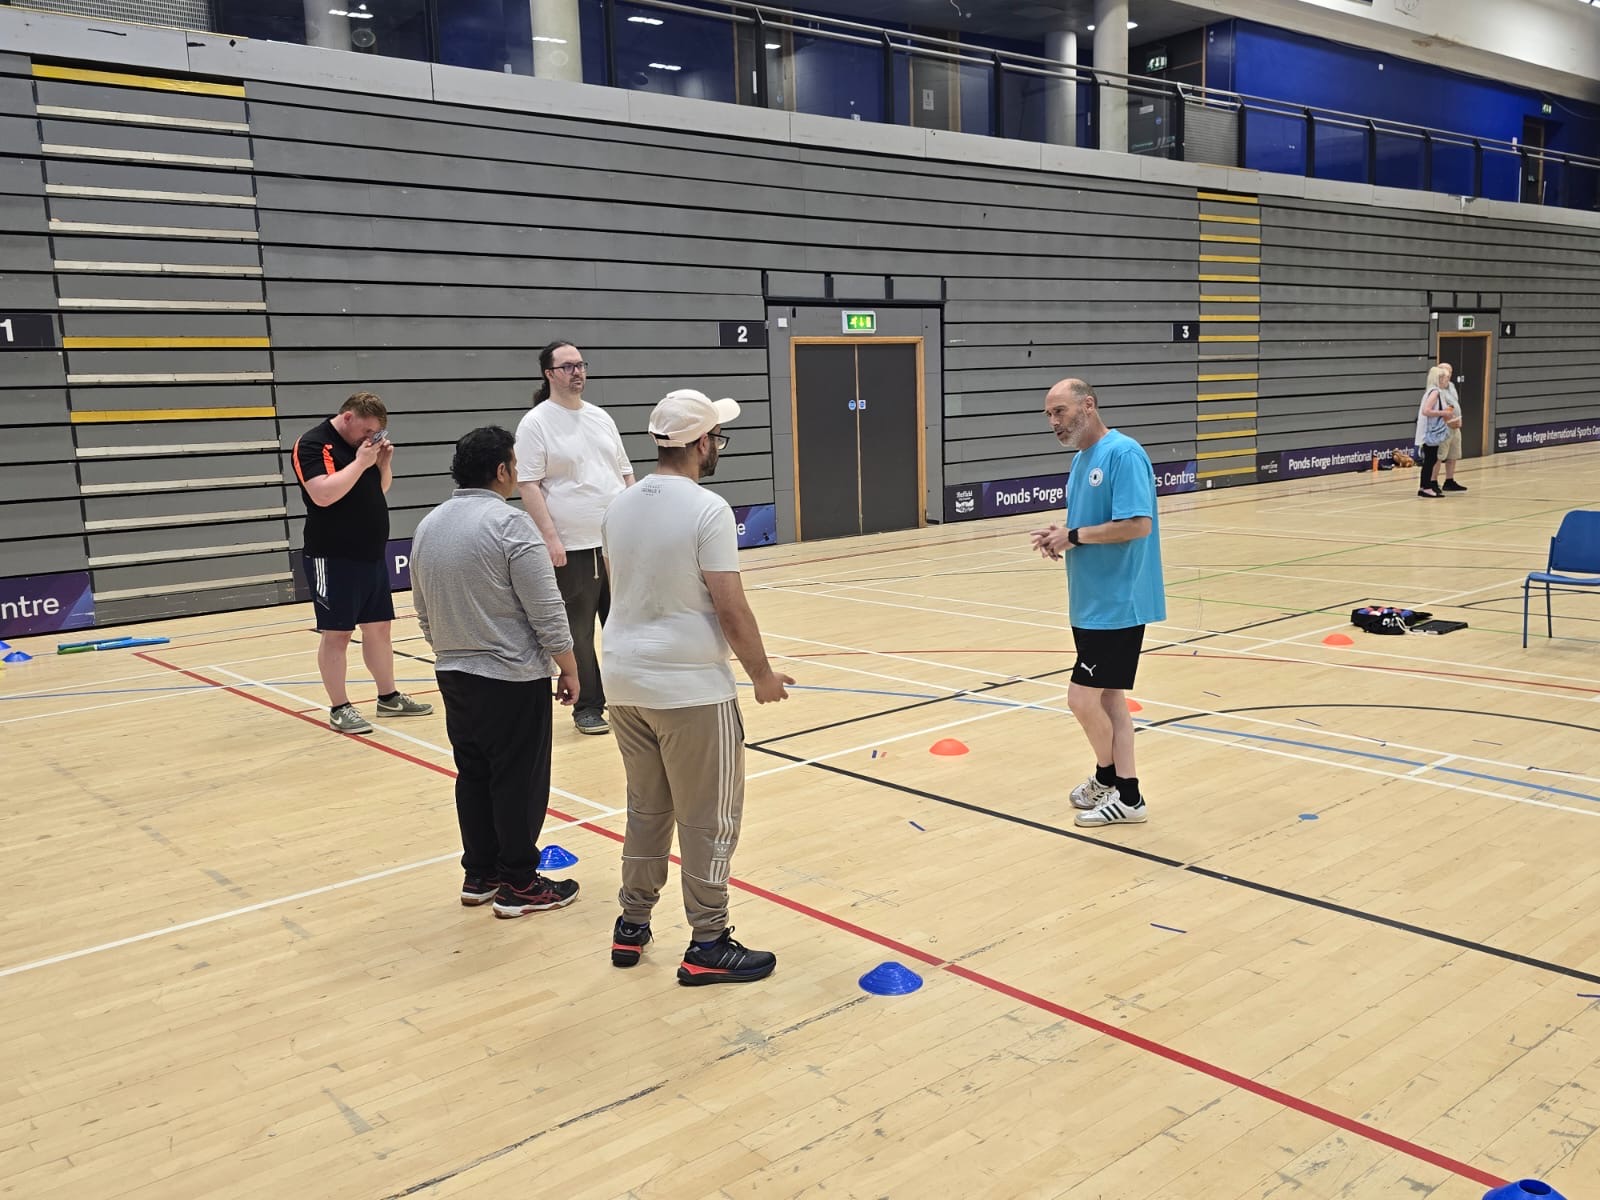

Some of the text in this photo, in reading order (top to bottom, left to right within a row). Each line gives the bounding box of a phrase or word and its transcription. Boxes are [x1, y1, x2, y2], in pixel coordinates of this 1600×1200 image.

[0, 319, 14, 342] 1
[737, 325, 748, 343] 2
[1182, 325, 1190, 339] 3
[1289, 457, 1310, 470] Ponds
[1312, 456, 1331, 470] Forge
[1332, 449, 1373, 466] International
[1373, 448, 1393, 461] Sports
[1164, 471, 1195, 486] Centre
[996, 487, 1031, 507] Ponds
[1033, 486, 1063, 503] Forge
[0, 595, 60, 620] ntre
